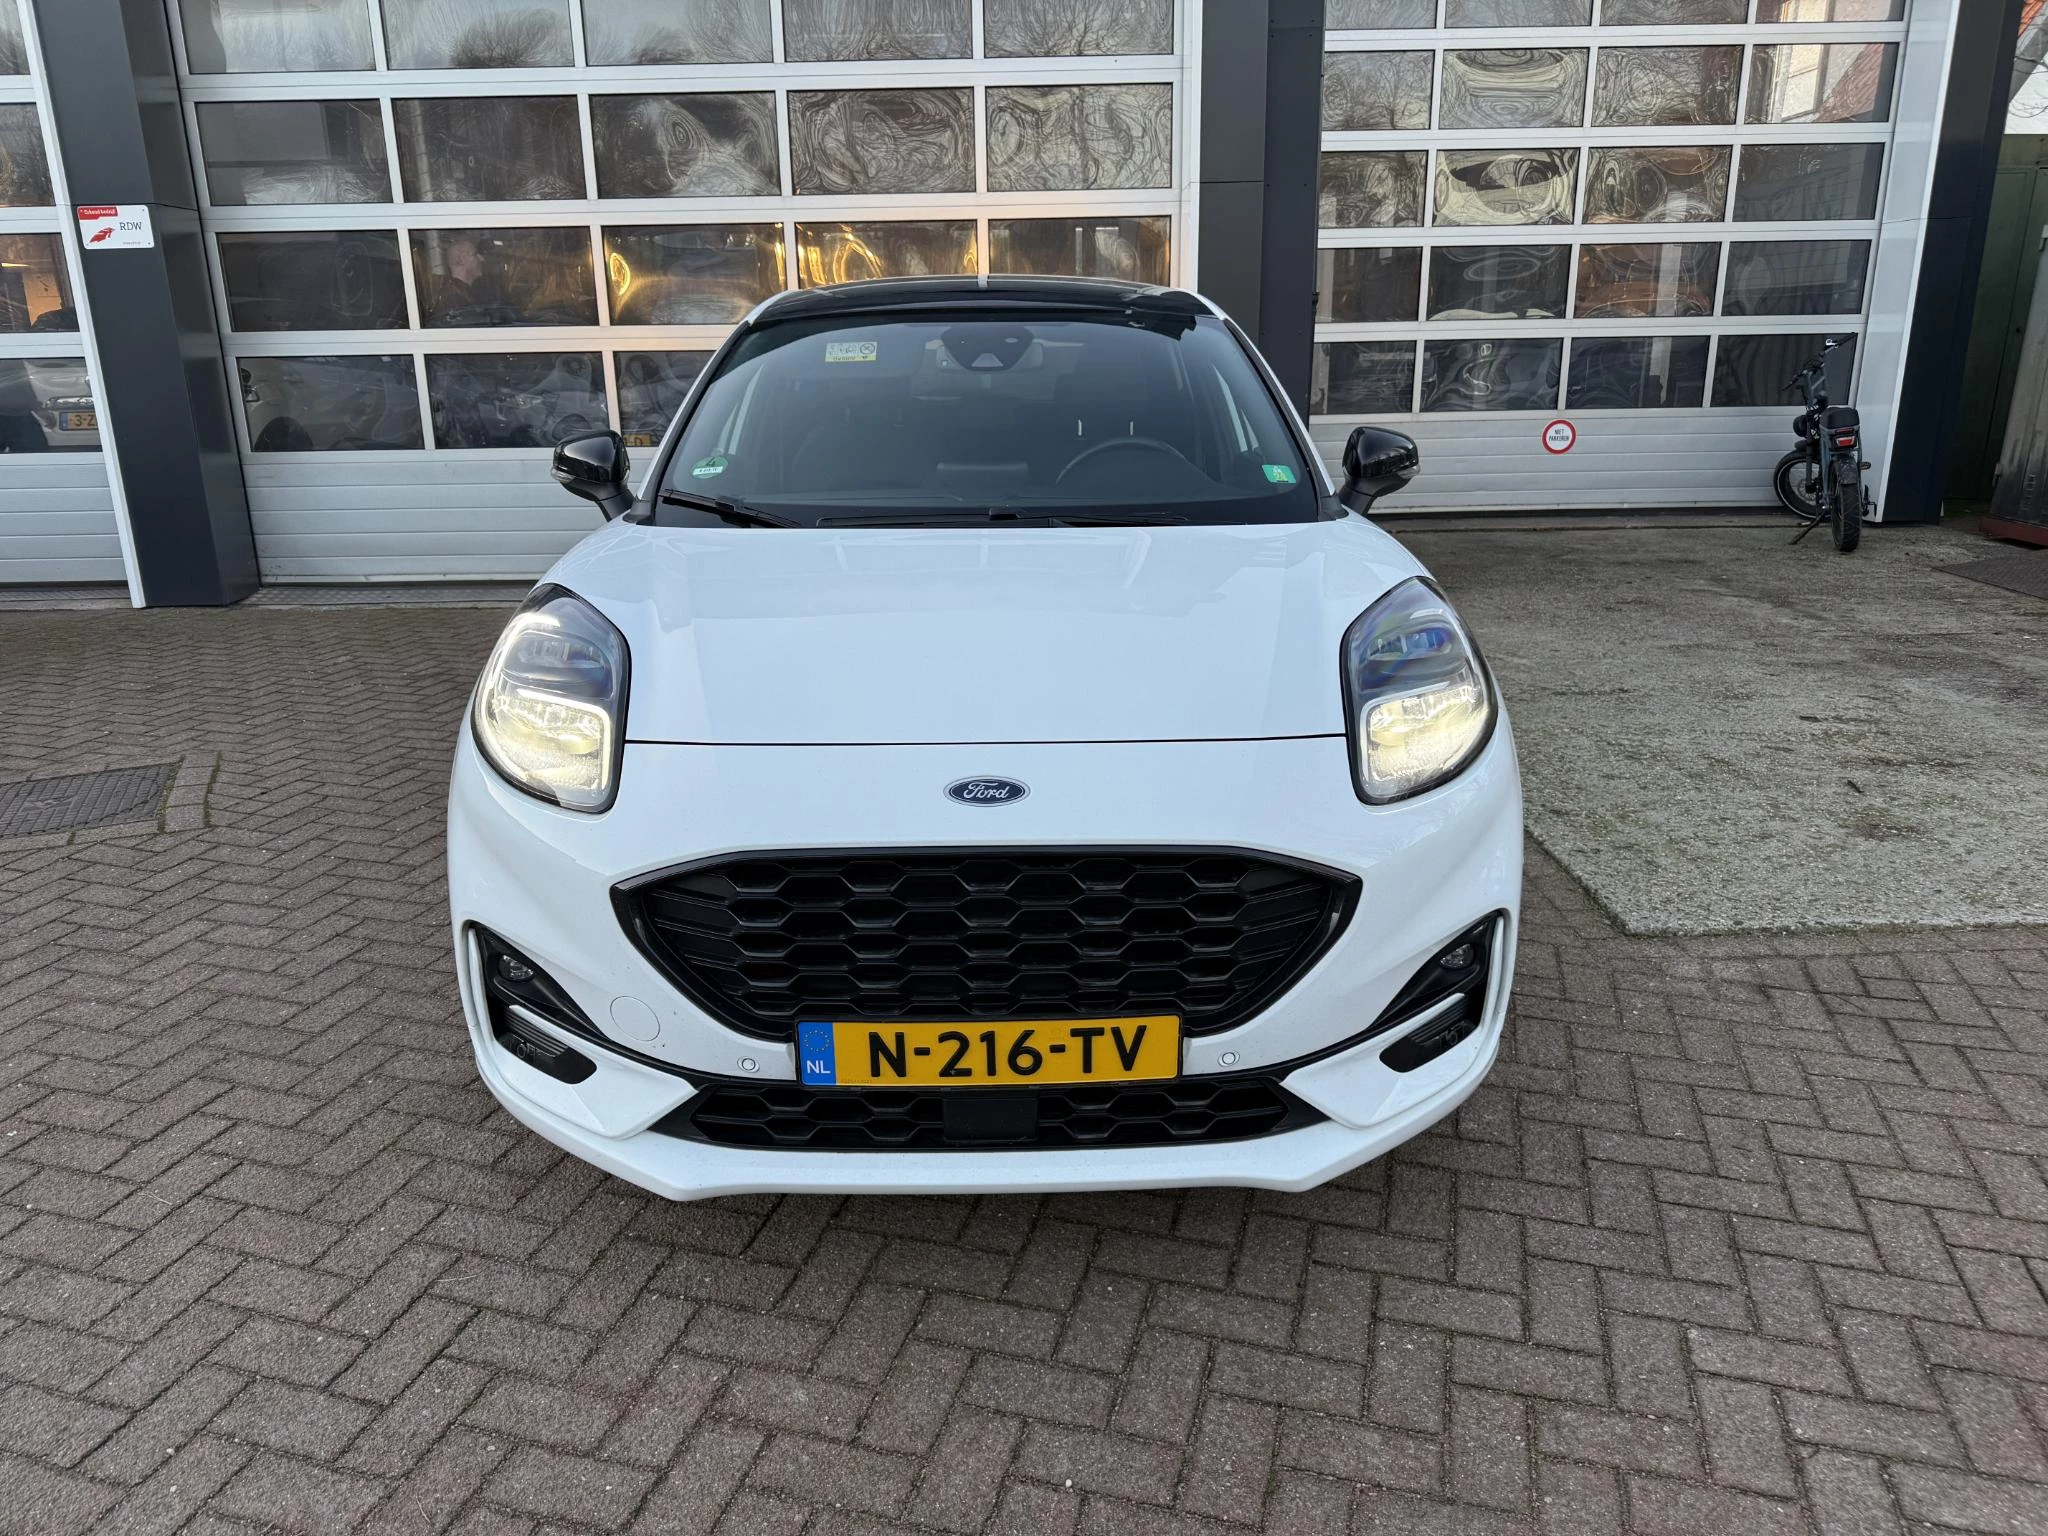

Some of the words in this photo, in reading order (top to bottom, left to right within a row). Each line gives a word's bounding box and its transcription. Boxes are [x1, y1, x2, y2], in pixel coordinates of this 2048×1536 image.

[119, 221, 142, 231] RDW
[963, 782, 1010, 799] Ford
[867, 1024, 1148, 1078] N-216-TV
[806, 1059, 831, 1075] NL
